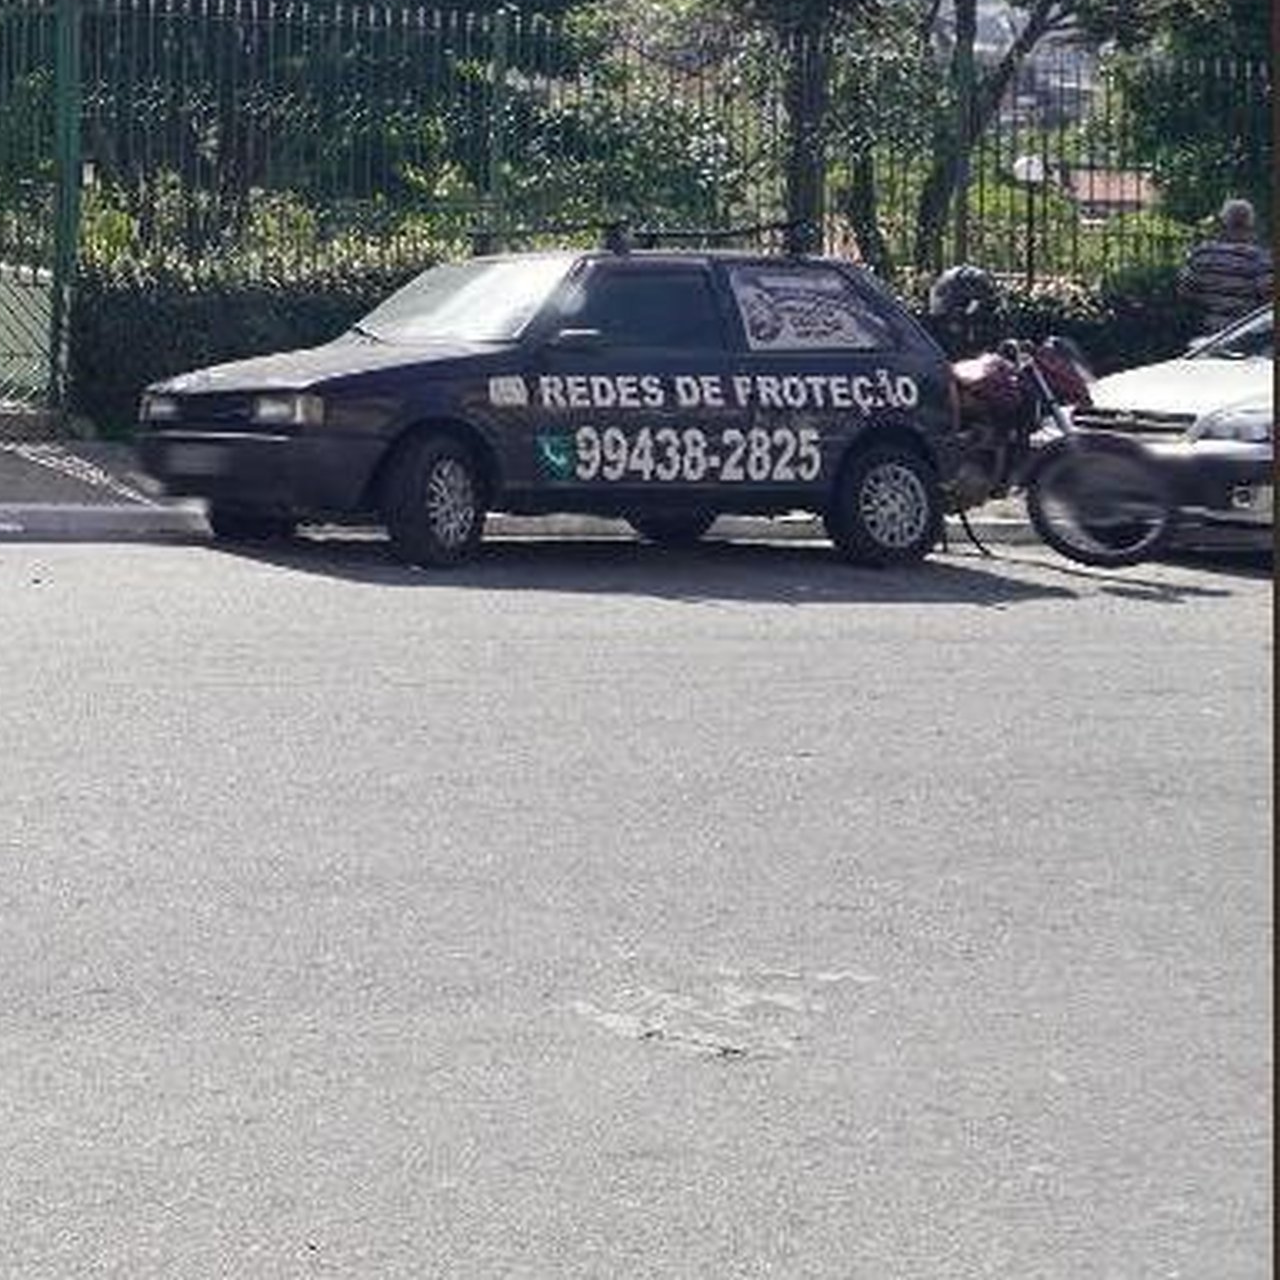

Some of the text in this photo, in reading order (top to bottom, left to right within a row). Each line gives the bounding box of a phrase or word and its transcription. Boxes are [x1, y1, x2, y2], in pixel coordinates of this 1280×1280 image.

[540, 376, 665, 407] REDES
[675, 376, 725, 407] DE
[575, 426, 821, 482] 99438-2825
